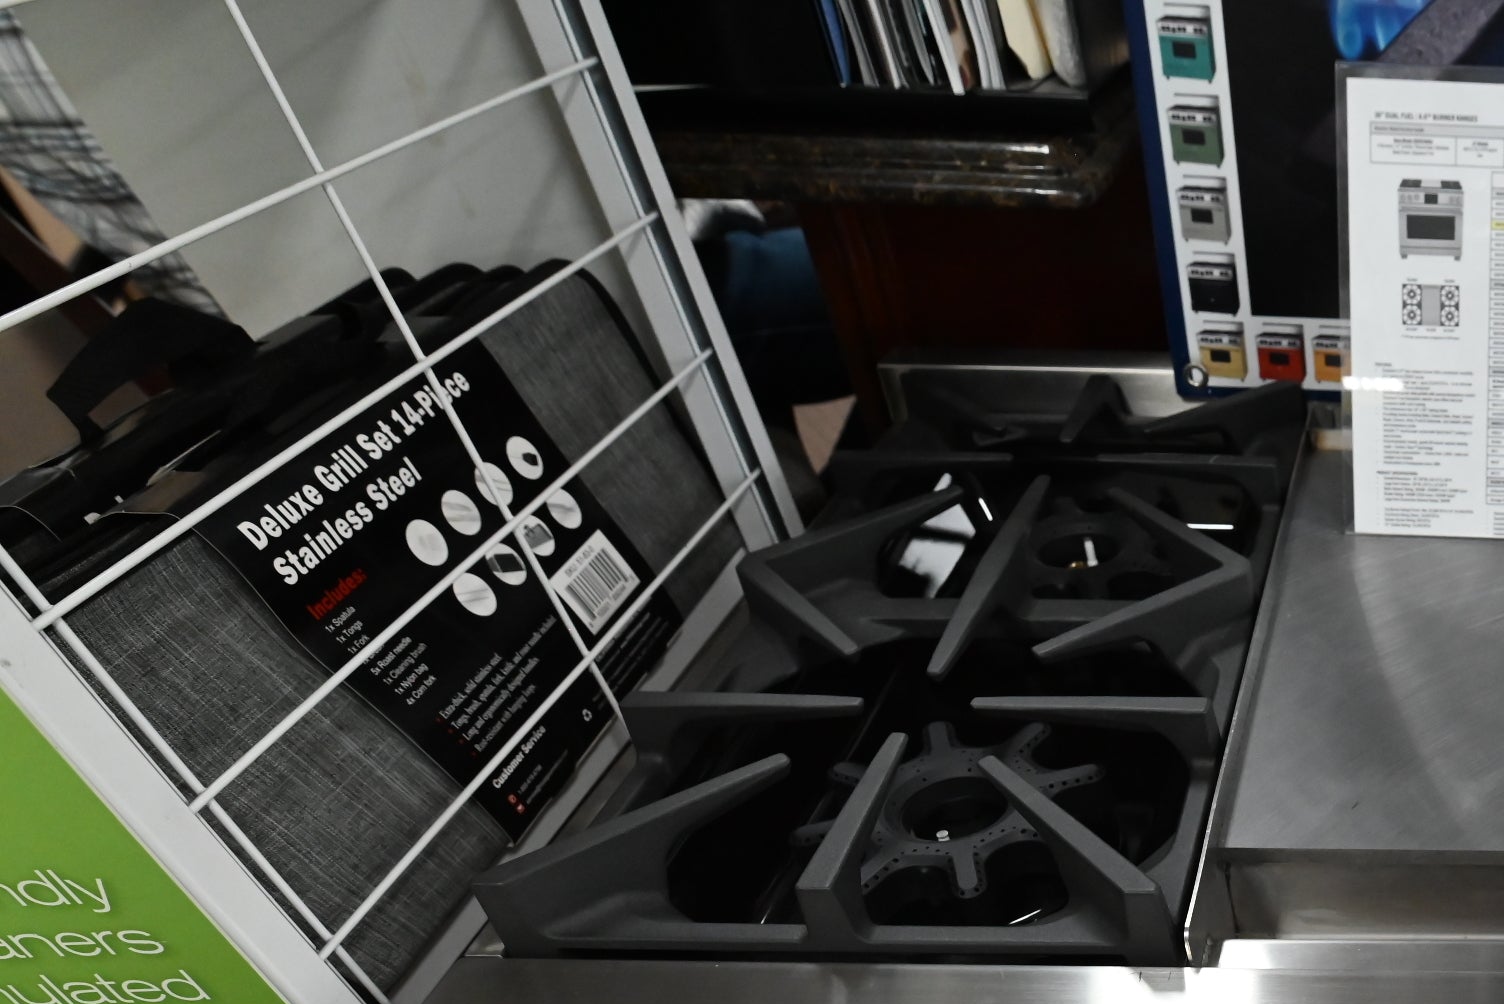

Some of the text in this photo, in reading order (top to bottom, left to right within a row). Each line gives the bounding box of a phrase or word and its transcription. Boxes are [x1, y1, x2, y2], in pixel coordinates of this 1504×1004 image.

[237, 484, 324, 551] Deluxe
[313, 444, 369, 492] Grill
[356, 420, 401, 461] Set
[273, 456, 422, 586] Stainless Steel
[306, 568, 368, 621] Includes:
[332, 605, 356, 627] Spatula
[342, 619, 363, 638] Tongs
[354, 634, 370, 650] Fork
[376, 654, 396, 670] Roast
[389, 656, 415, 679] Cleaning
[400, 671, 418, 690] Nylon
[492, 751, 525, 789] Customer
[521, 726, 546, 754] Service
